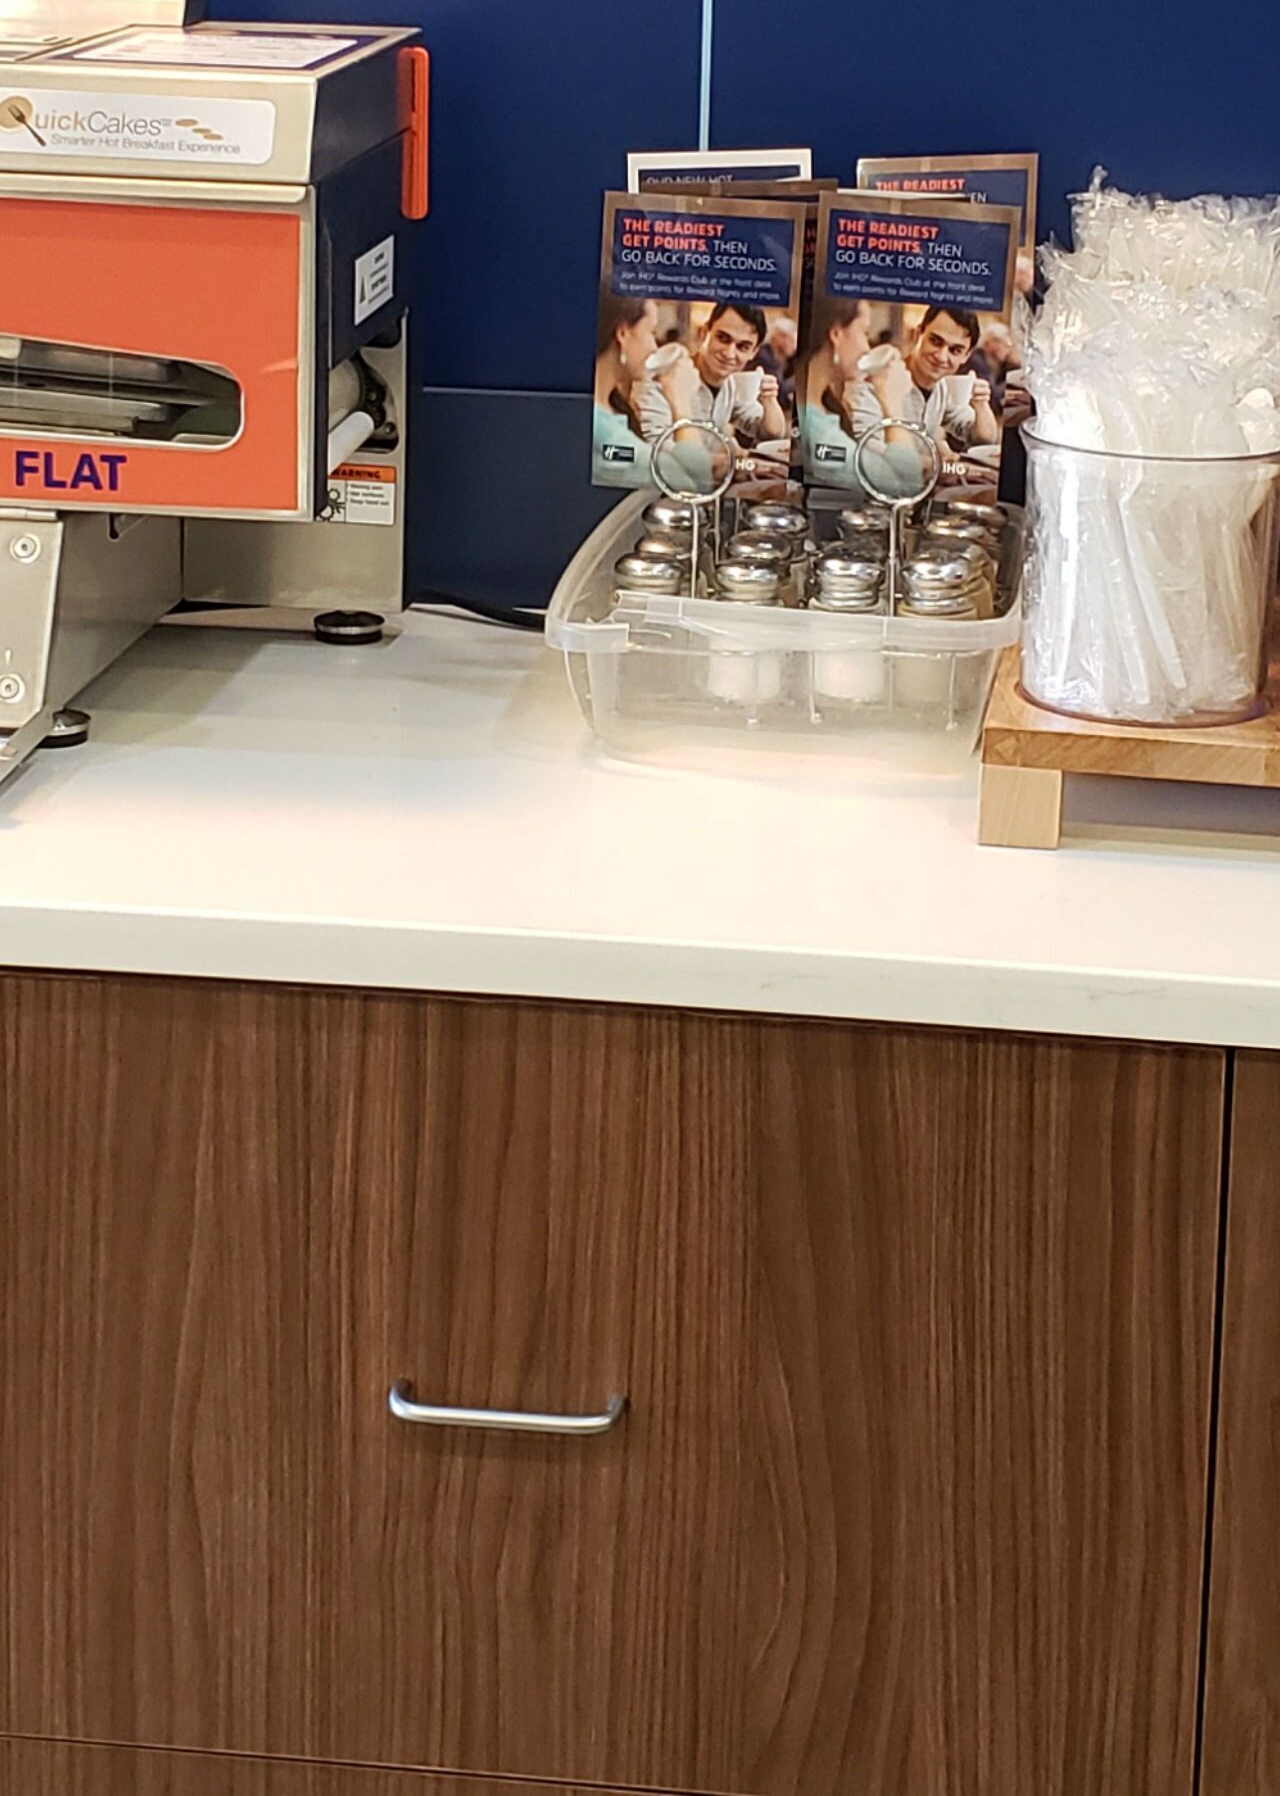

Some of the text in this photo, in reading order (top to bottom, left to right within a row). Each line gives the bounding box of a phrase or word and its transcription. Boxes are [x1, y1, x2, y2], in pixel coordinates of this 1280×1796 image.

[51, 133, 240, 155] Smarter Hot Breakfast Experience
[876, 178, 965, 192] THE READIEST
[623, 218, 724, 237] THE READIEST
[838, 219, 939, 239] THE READIEST
[622, 234, 650, 248] GET
[713, 240, 748, 254] THEN
[837, 234, 864, 247] GET
[927, 242, 962, 257] THEN
[621, 249, 777, 271] GO BACK FOR SECONDS.
[836, 250, 992, 276] GO BACK FOR SECONDS.
[15, 450, 128, 491] FLAT
[735, 458, 756, 472] HG
[942, 462, 966, 476] IHG
